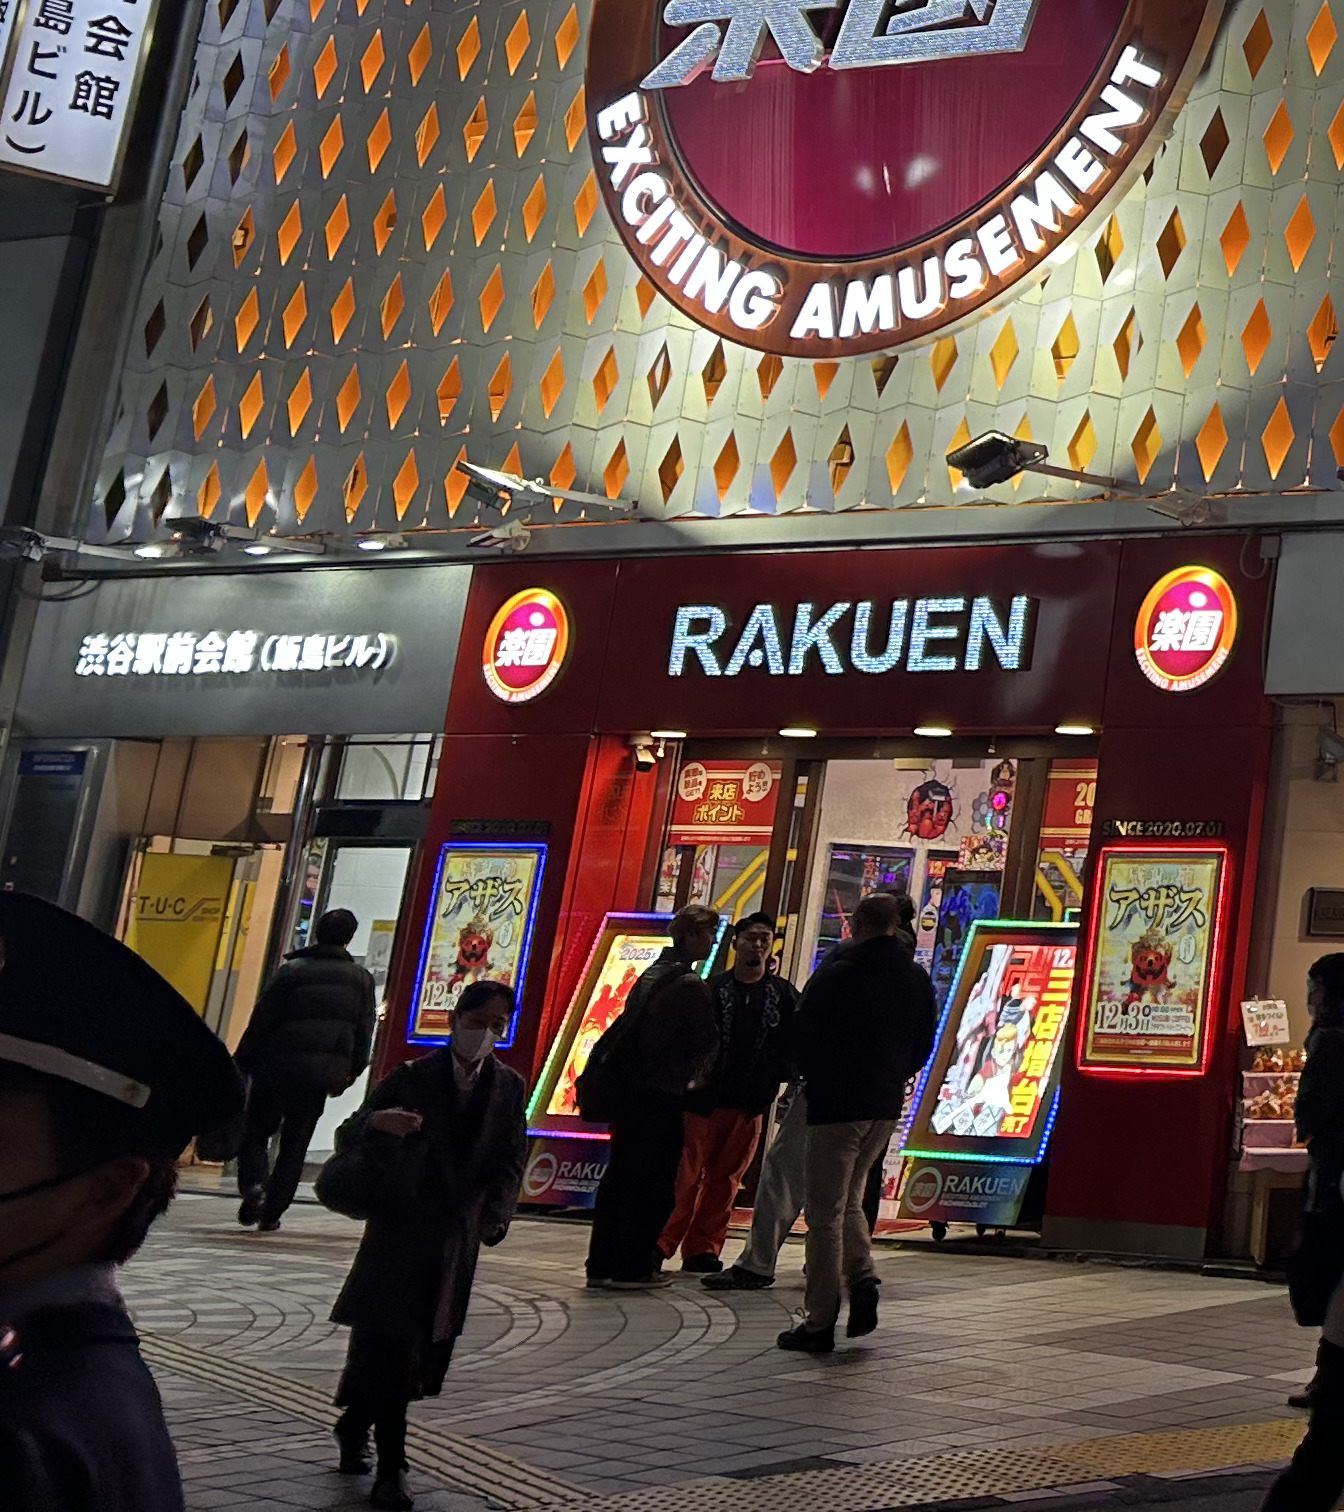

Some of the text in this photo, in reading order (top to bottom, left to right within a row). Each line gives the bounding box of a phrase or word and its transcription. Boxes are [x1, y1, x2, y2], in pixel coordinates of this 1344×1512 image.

[597, 44, 1165, 339] EXCITING AMUSEMENT
[494, 627, 557, 666] 楽園
[667, 595, 1030, 677] RAKUEN
[1149, 608, 1223, 651] 楽園
[694, 803, 744, 823] ポイント
[709, 783, 738, 801] 来店
[442, 876, 523, 922] アザス
[1109, 884, 1206, 934] アザス
[943, 1175, 1026, 1195] RAKUEN
